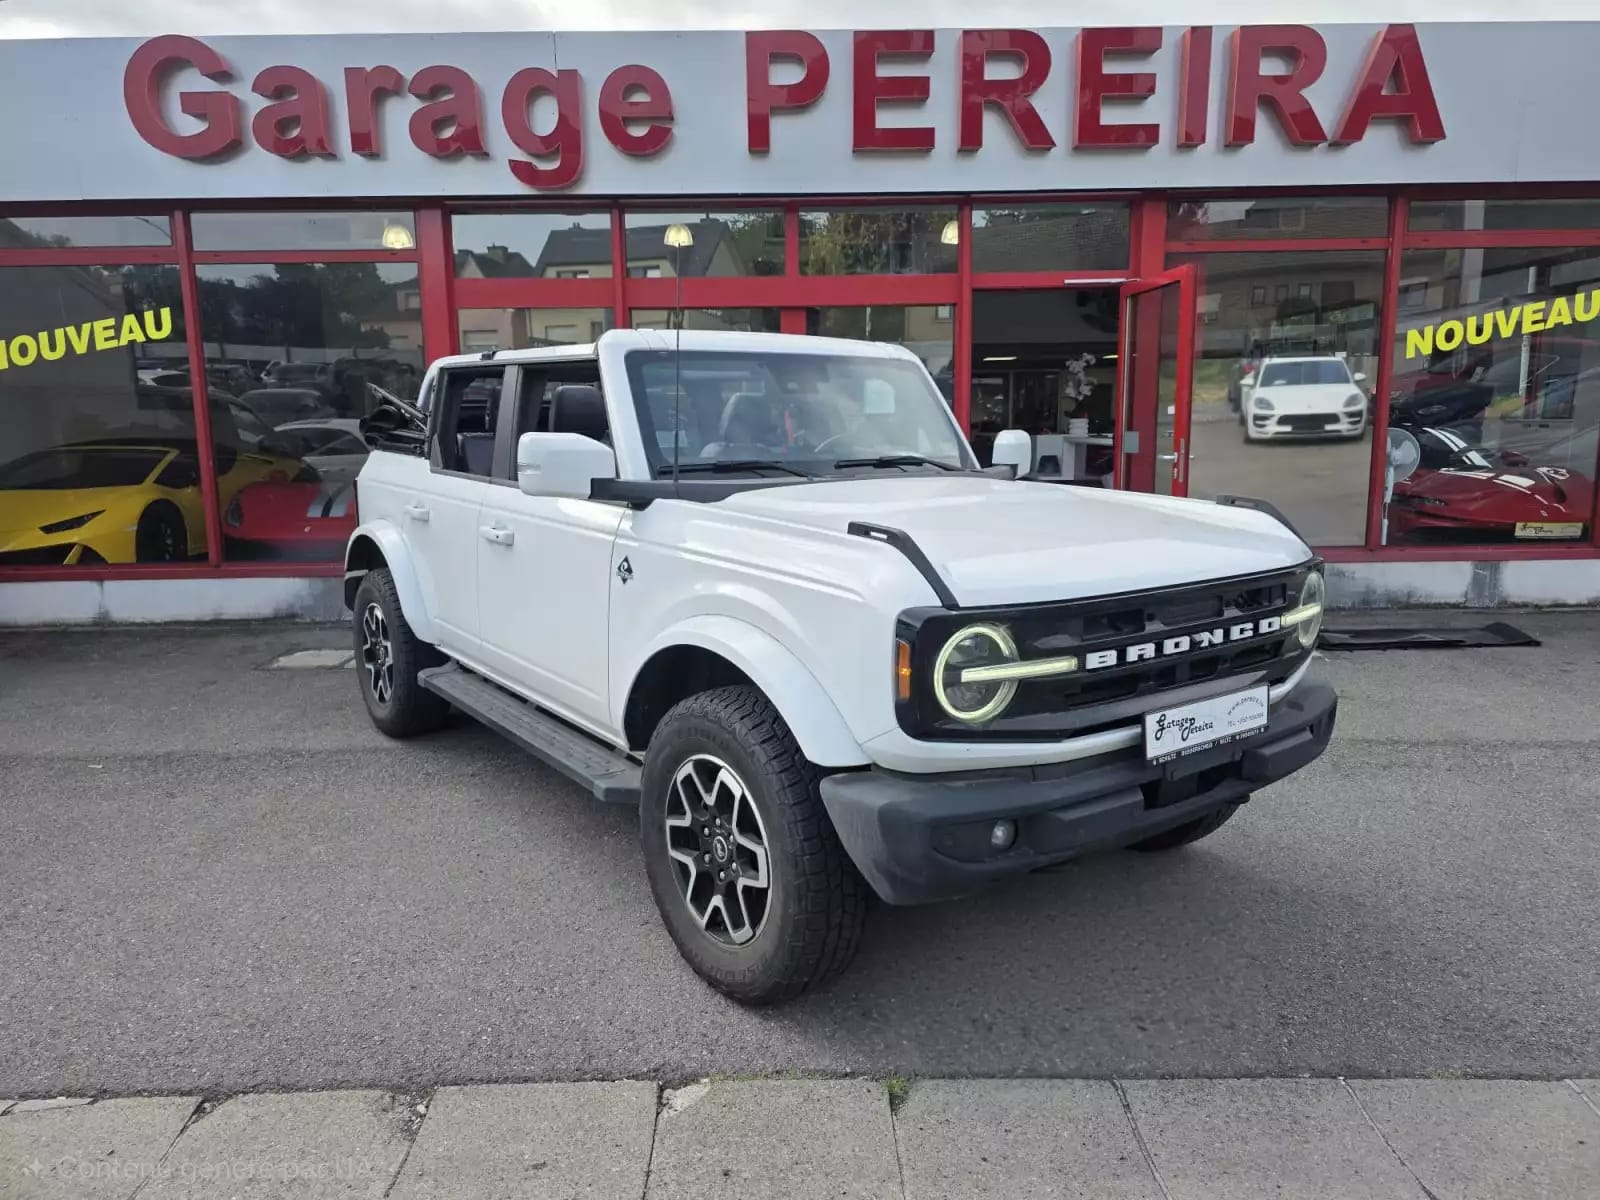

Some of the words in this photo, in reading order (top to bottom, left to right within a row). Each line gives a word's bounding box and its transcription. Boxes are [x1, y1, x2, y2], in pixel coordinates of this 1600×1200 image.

[124, 34, 675, 190] Garage
[746, 23, 1446, 154] PEREIRA
[1405, 289, 1600, 360] NOUVEAU
[1085, 616, 1281, 670] BRONCO
[1154, 713, 1190, 741] Garage
[1181, 717, 1213, 741] Pereira
